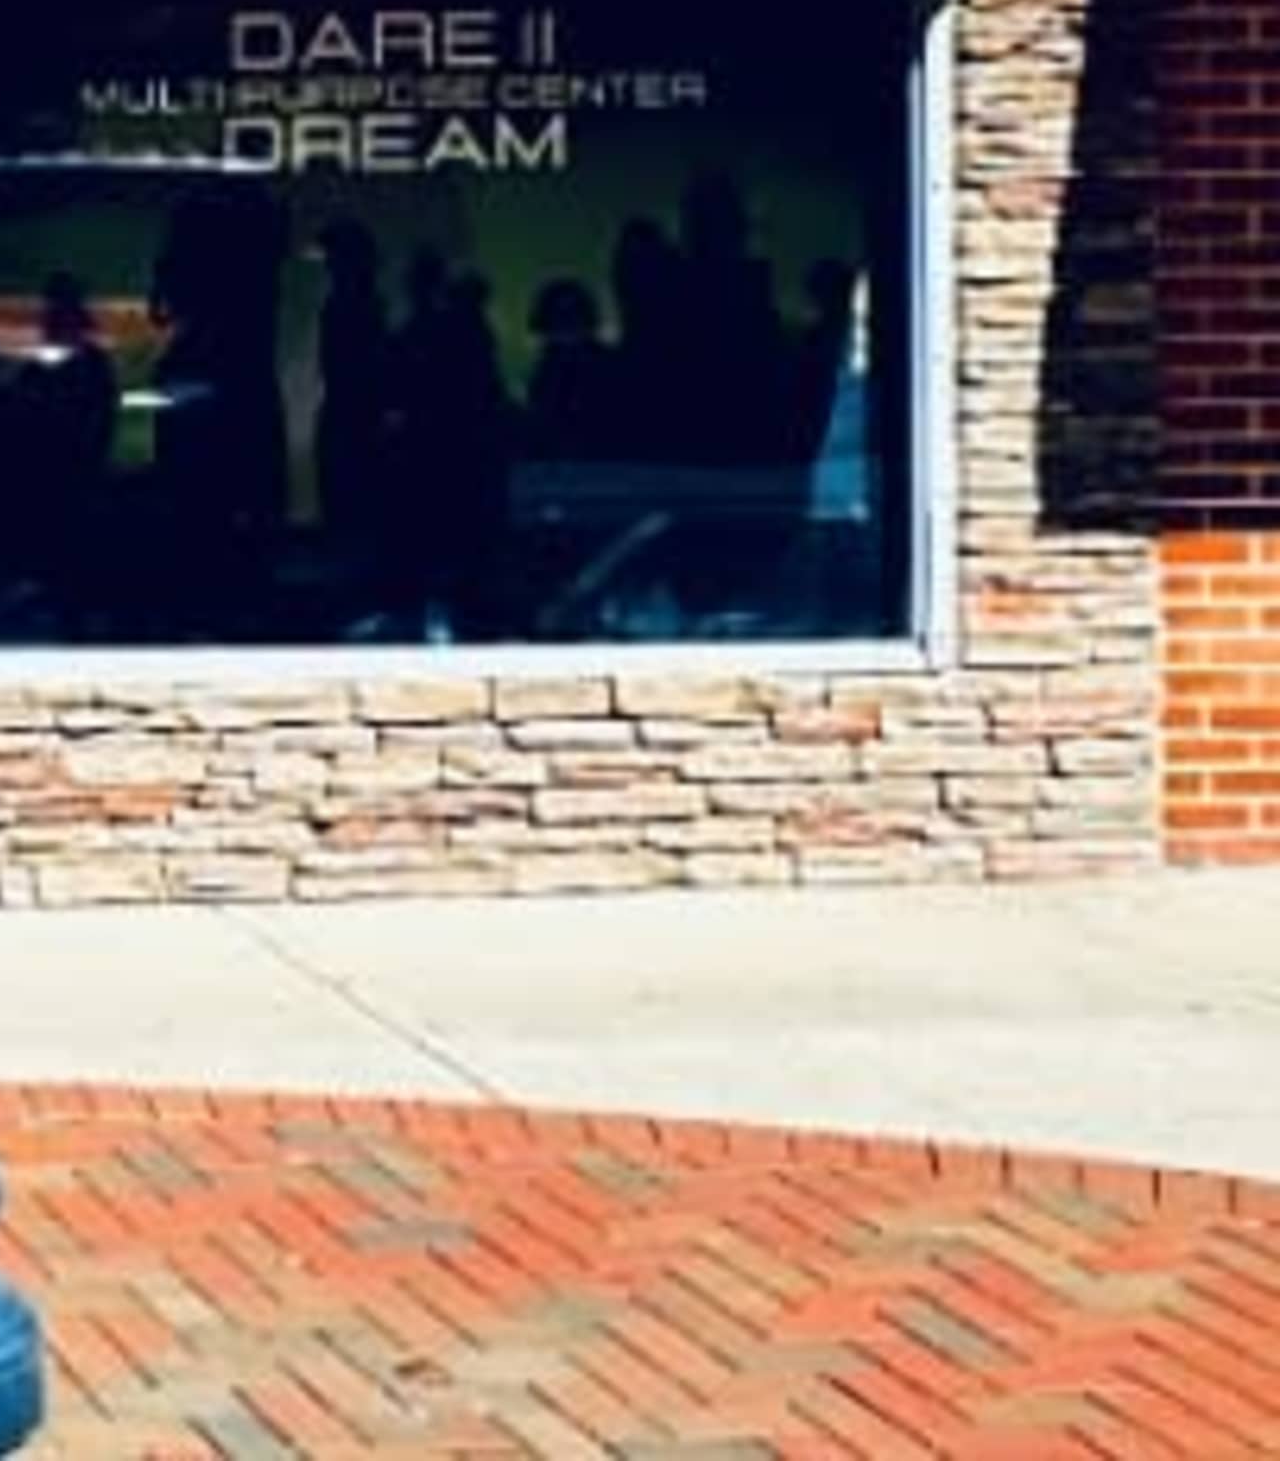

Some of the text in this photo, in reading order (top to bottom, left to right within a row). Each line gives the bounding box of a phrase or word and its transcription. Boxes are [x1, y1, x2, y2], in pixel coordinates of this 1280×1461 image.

[230, 10, 497, 70] DARE
[498, 71, 708, 109] CENTER
[223, 113, 568, 172] DREAM
